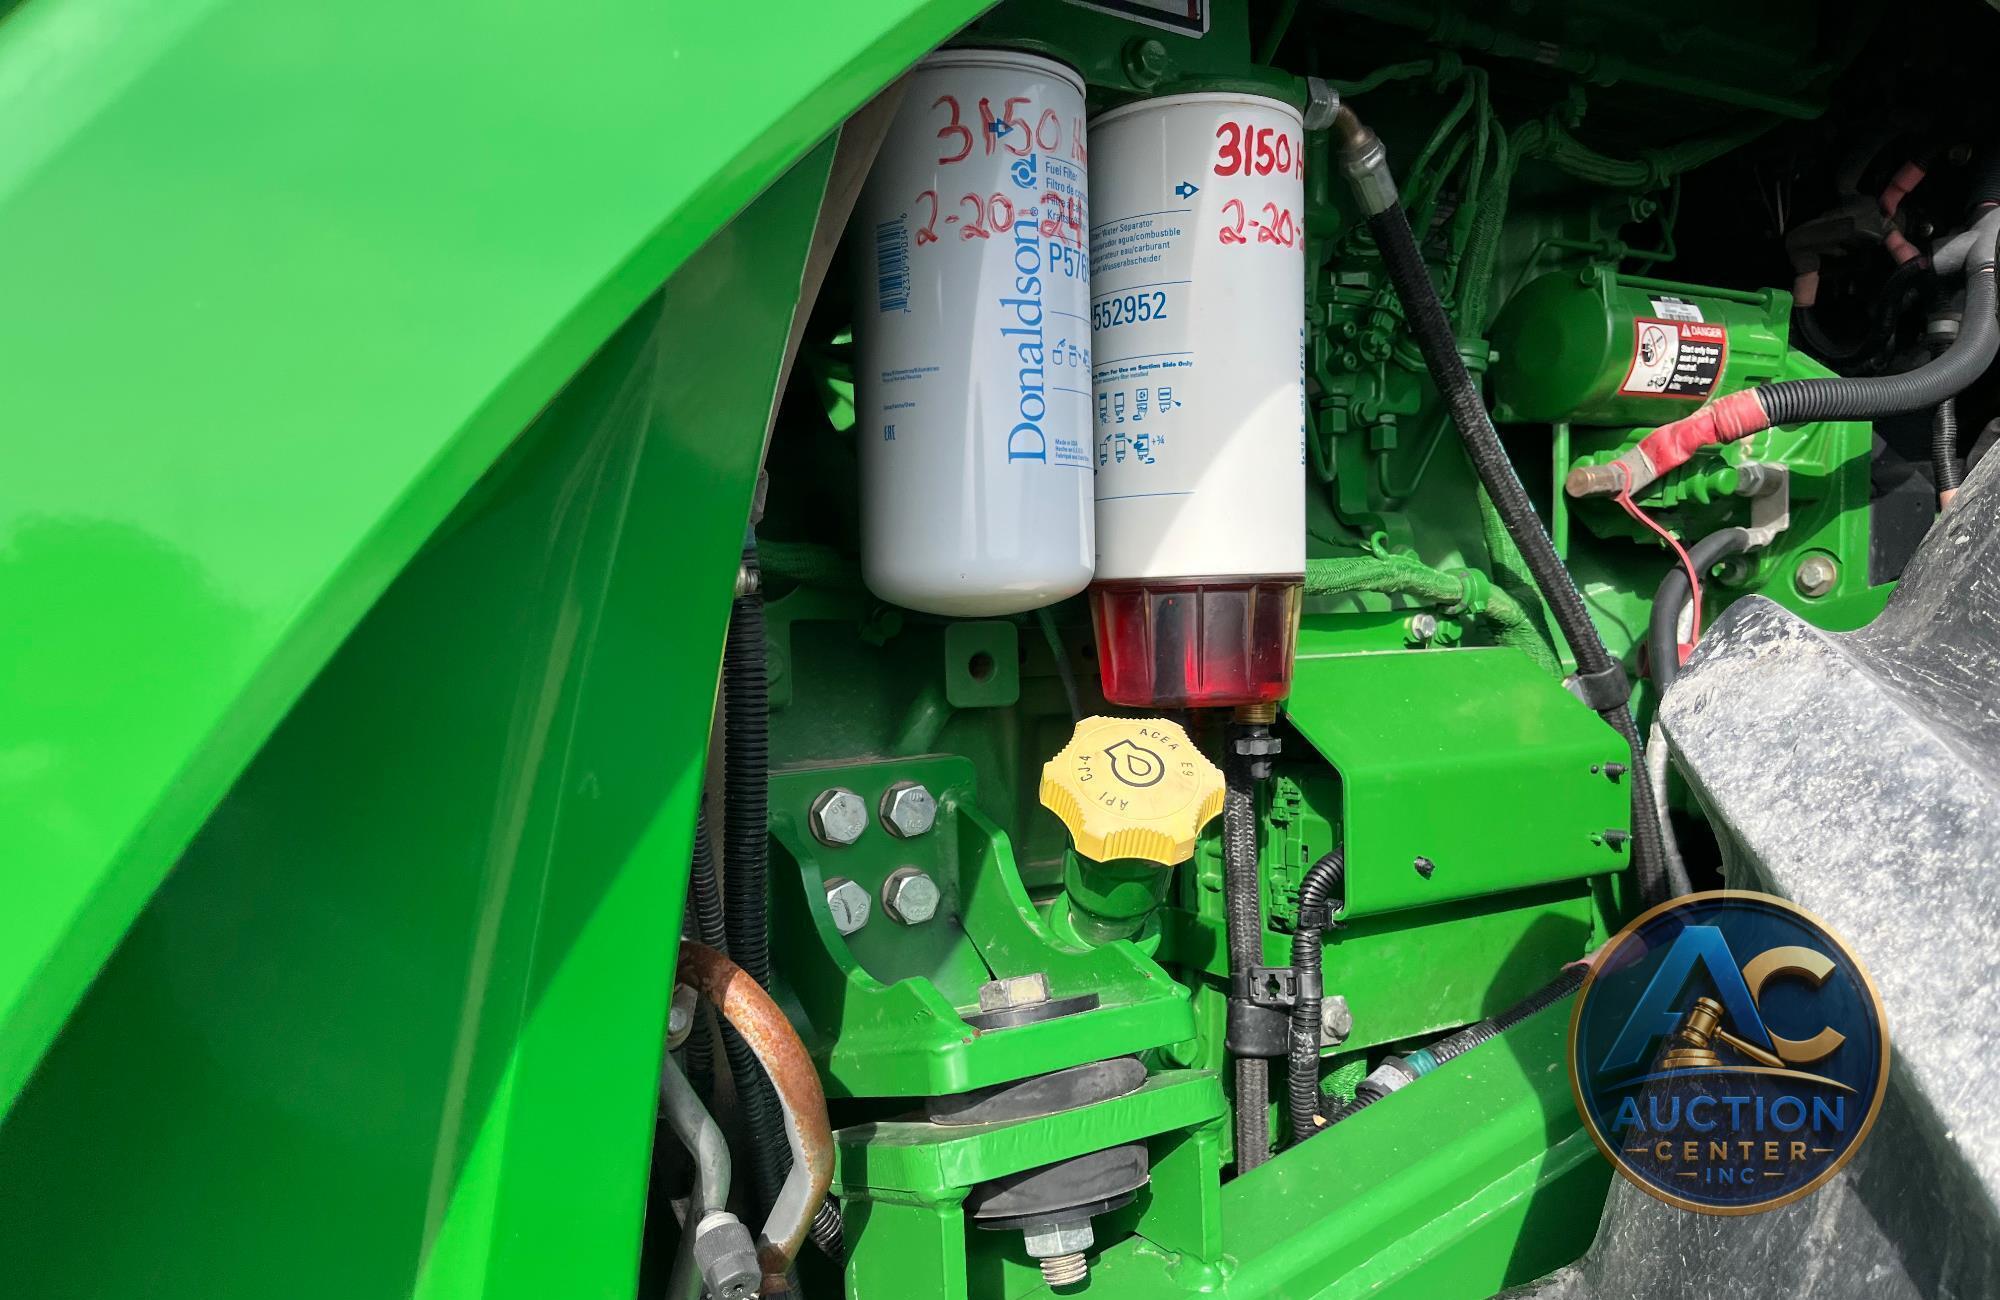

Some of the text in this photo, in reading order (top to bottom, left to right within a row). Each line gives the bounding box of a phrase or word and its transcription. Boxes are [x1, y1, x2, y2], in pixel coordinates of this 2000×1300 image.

[931, 95, 1063, 165] 3150
[1214, 121, 1291, 177] 3150
[1045, 161, 1078, 182] Fuel Filter
[1046, 177, 1066, 193] Filtro
[1067, 184, 1074, 196] de
[916, 189, 1082, 248] 2-20-24
[1119, 220, 1153, 233] Separator
[1118, 228, 1181, 246] agua/combustible
[1120, 241, 1170, 257] eau/carburant
[1102, 254, 1161, 272] Wasserabscheider
[1091, 291, 1167, 332] 552952
[1691, 325, 1722, 338] DANGER
[1680, 344, 1719, 356] Start only from
[1138, 363, 1161, 371] Suction
[1178, 360, 1193, 368] Only
[1697, 356, 1710, 365] park
[1672, 373, 1695, 385] Starting
[1699, 377, 1713, 386] gear
[1139, 728, 1180, 751] ACEA
[1079, 755, 1129, 811] API CJ-4
